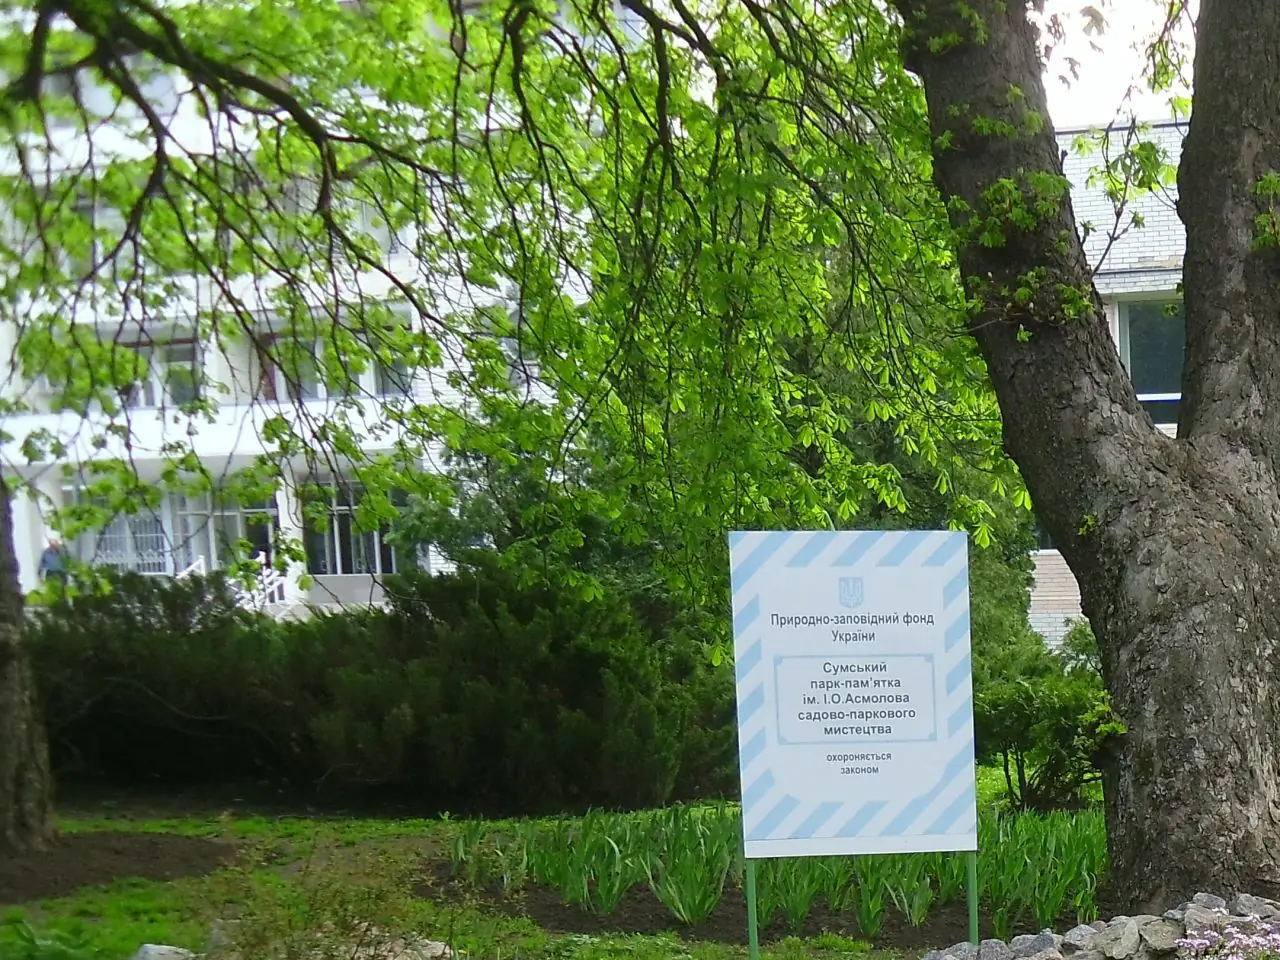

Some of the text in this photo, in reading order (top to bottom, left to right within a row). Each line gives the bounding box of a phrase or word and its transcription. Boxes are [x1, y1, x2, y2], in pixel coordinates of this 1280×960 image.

[771, 612, 935, 628] Природно-заповідний фонд
[831, 630, 876, 644] України
[823, 662, 887, 675] Сумський
[803, 693, 820, 705] ім.
[798, 709, 916, 721] садово-паркового
[824, 724, 892, 736] мистецтва
[826, 752, 892, 763] охороняється
[840, 765, 879, 775] законом
